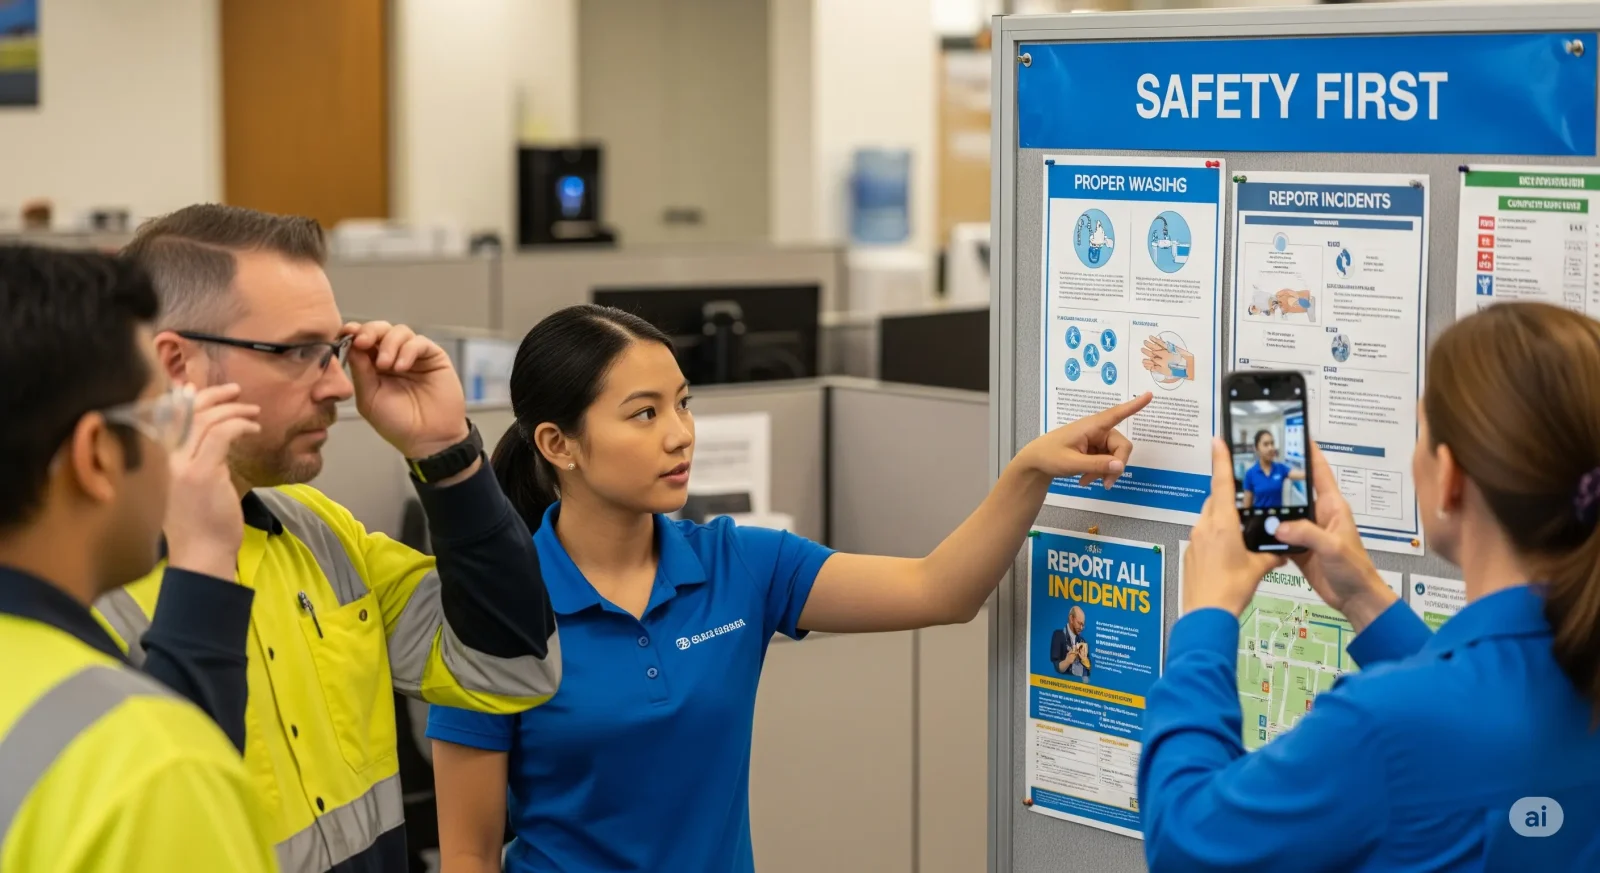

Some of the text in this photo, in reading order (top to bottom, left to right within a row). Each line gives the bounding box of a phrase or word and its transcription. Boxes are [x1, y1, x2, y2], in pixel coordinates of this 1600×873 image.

[1136, 71, 1448, 121] SAFETY FIRST
[1074, 174, 1125, 191] PROPER
[1322, 191, 1391, 209] INCIDENTS
[1047, 549, 1150, 587] REPORT ALL
[1048, 574, 1151, 614] INCIDENTS
